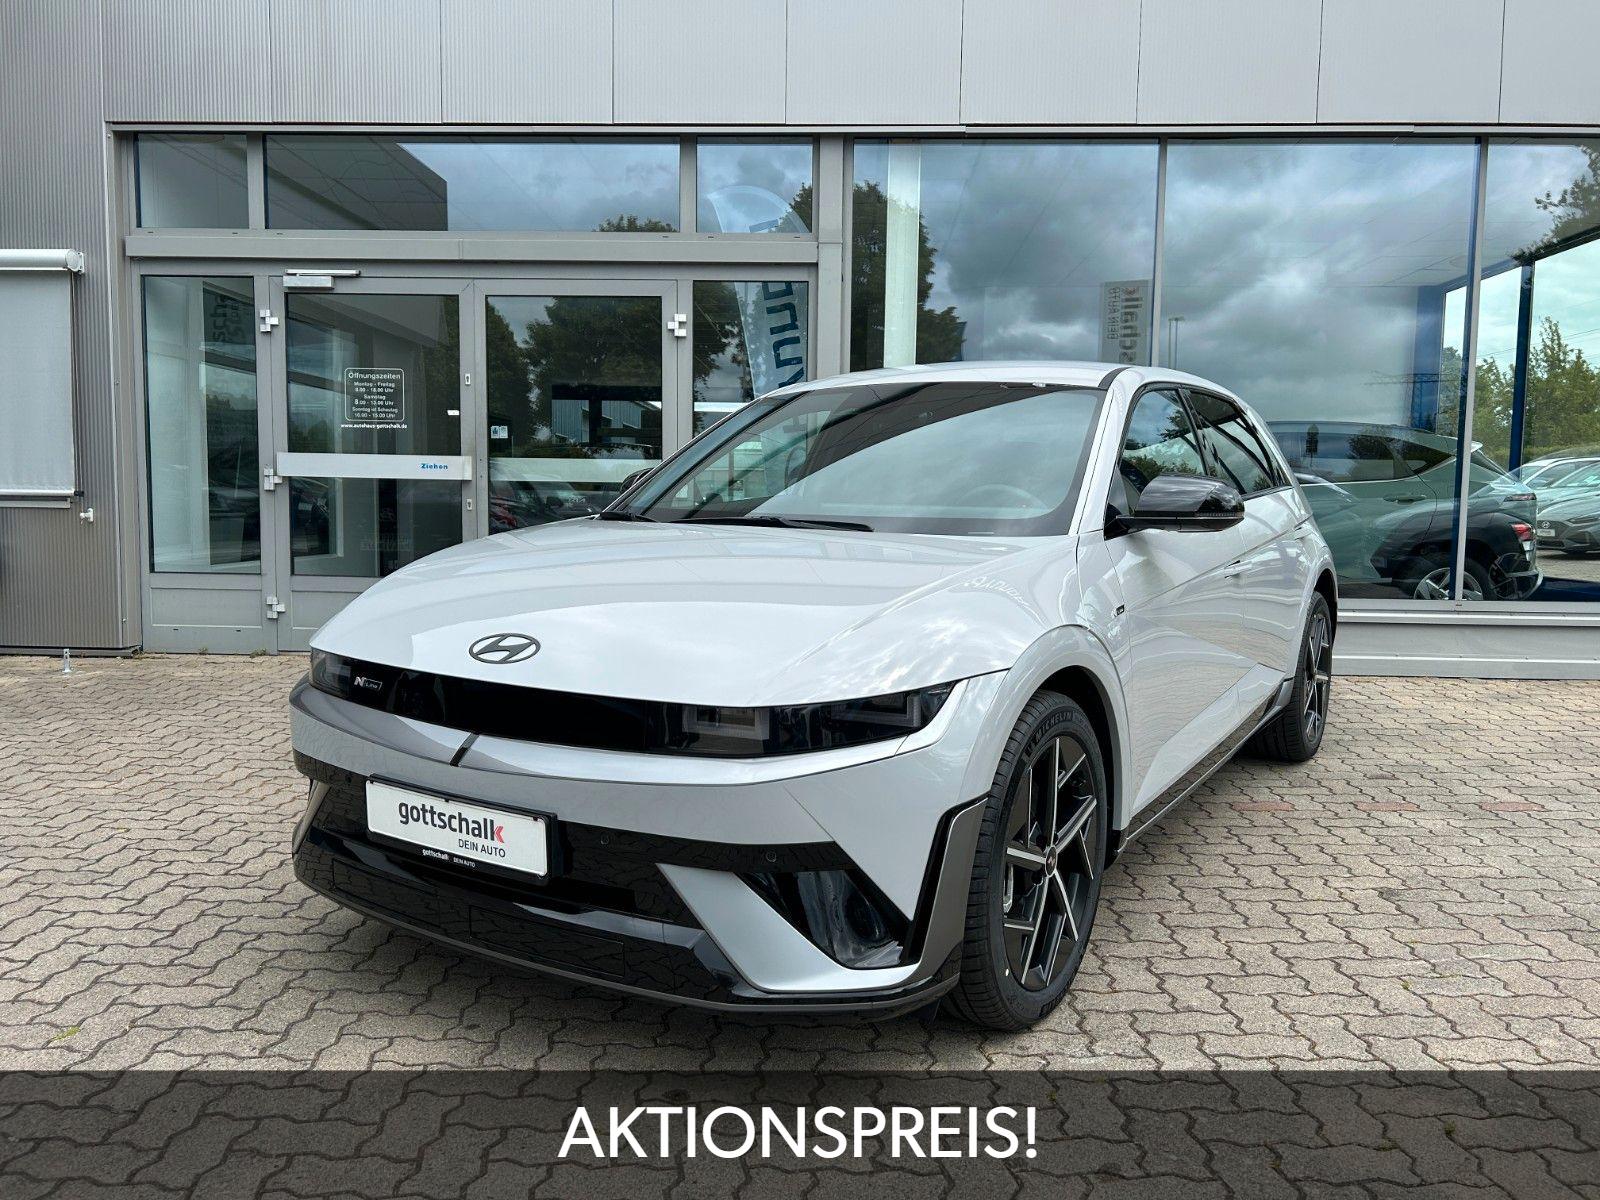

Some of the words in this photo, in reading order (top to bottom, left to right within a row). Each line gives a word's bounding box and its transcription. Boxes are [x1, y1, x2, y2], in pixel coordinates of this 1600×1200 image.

[348, 371, 401, 380] Öffnungszeiten
[1035, 711, 1072, 742] MICHELIN
[398, 801, 505, 843] gottschalk
[422, 848, 450, 861] gottschalk
[458, 838, 478, 852] DEIN
[480, 844, 506, 858] AUTO
[453, 856, 464, 864] DEIN
[464, 859, 476, 868] AUTO
